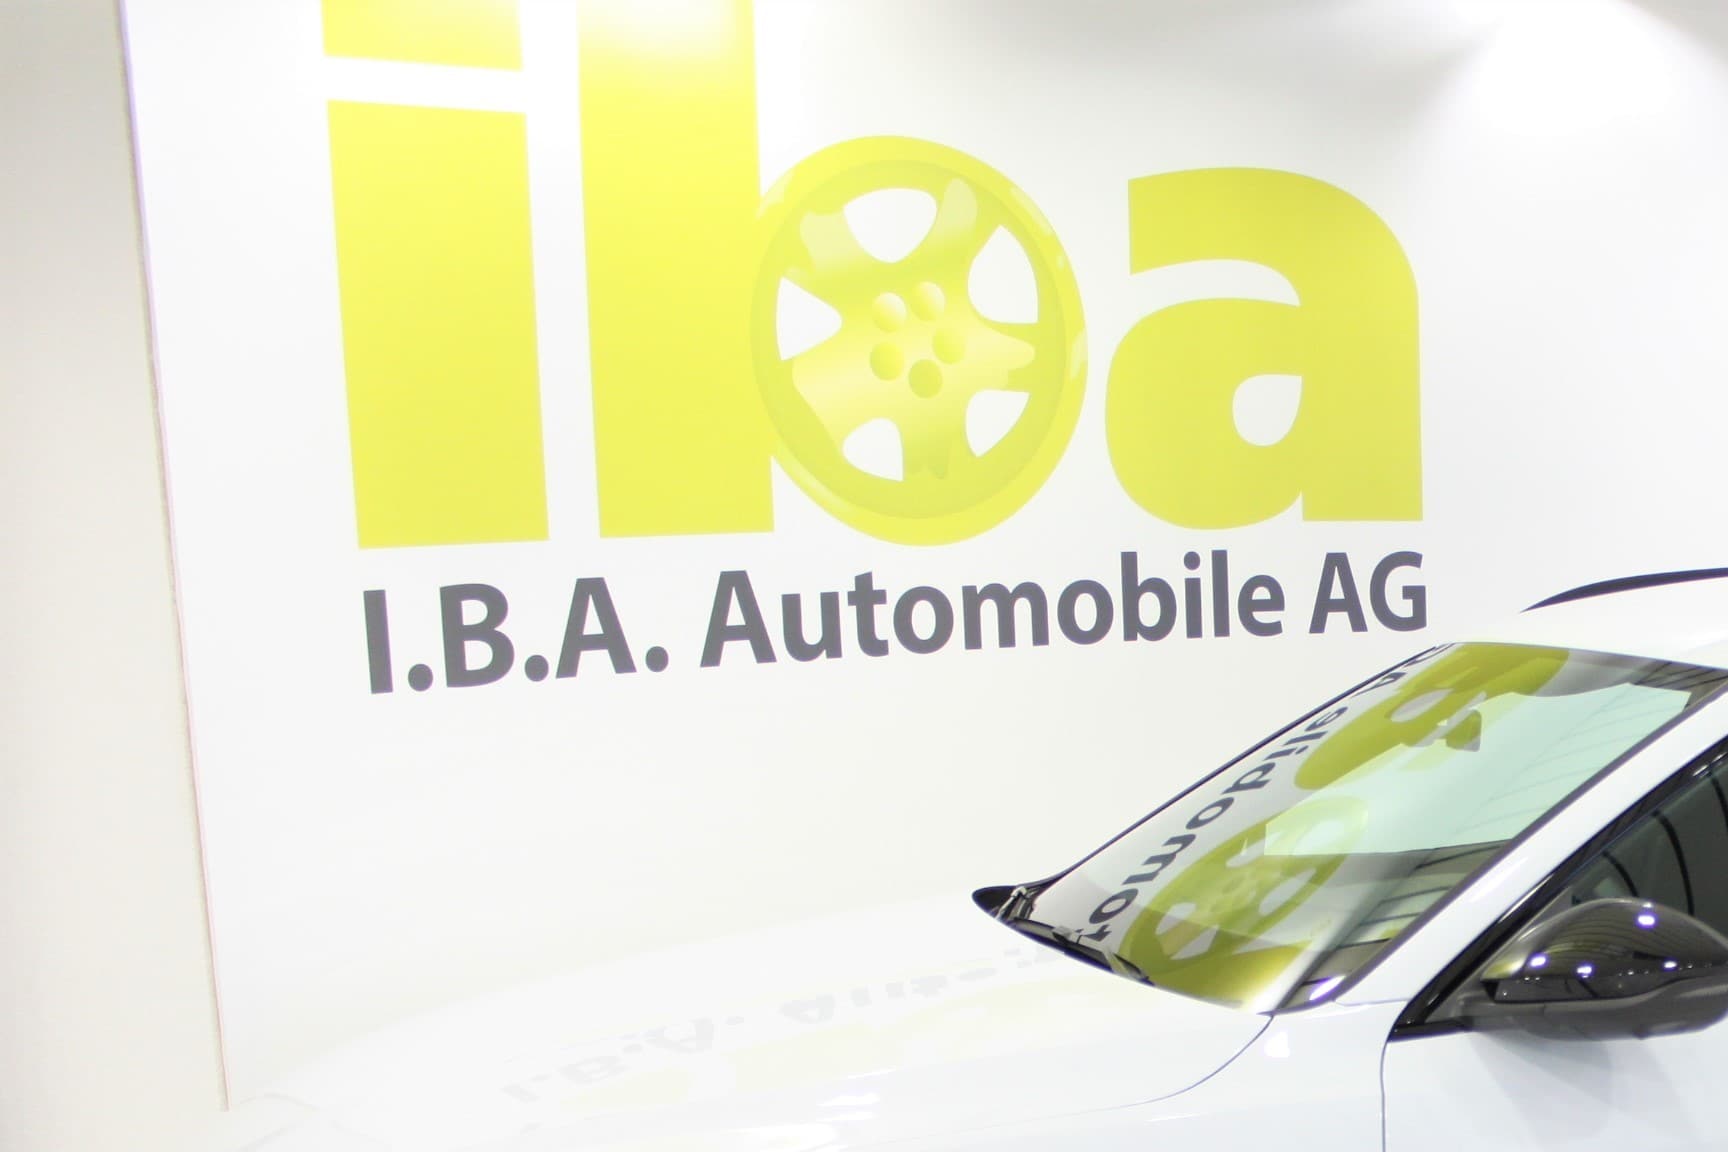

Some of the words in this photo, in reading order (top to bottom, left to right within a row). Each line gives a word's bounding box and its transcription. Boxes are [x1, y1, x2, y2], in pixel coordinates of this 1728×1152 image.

[363, 576, 669, 694] I.B.A.
[699, 549, 1286, 668] Automobile
[1308, 550, 1428, 635] AG
